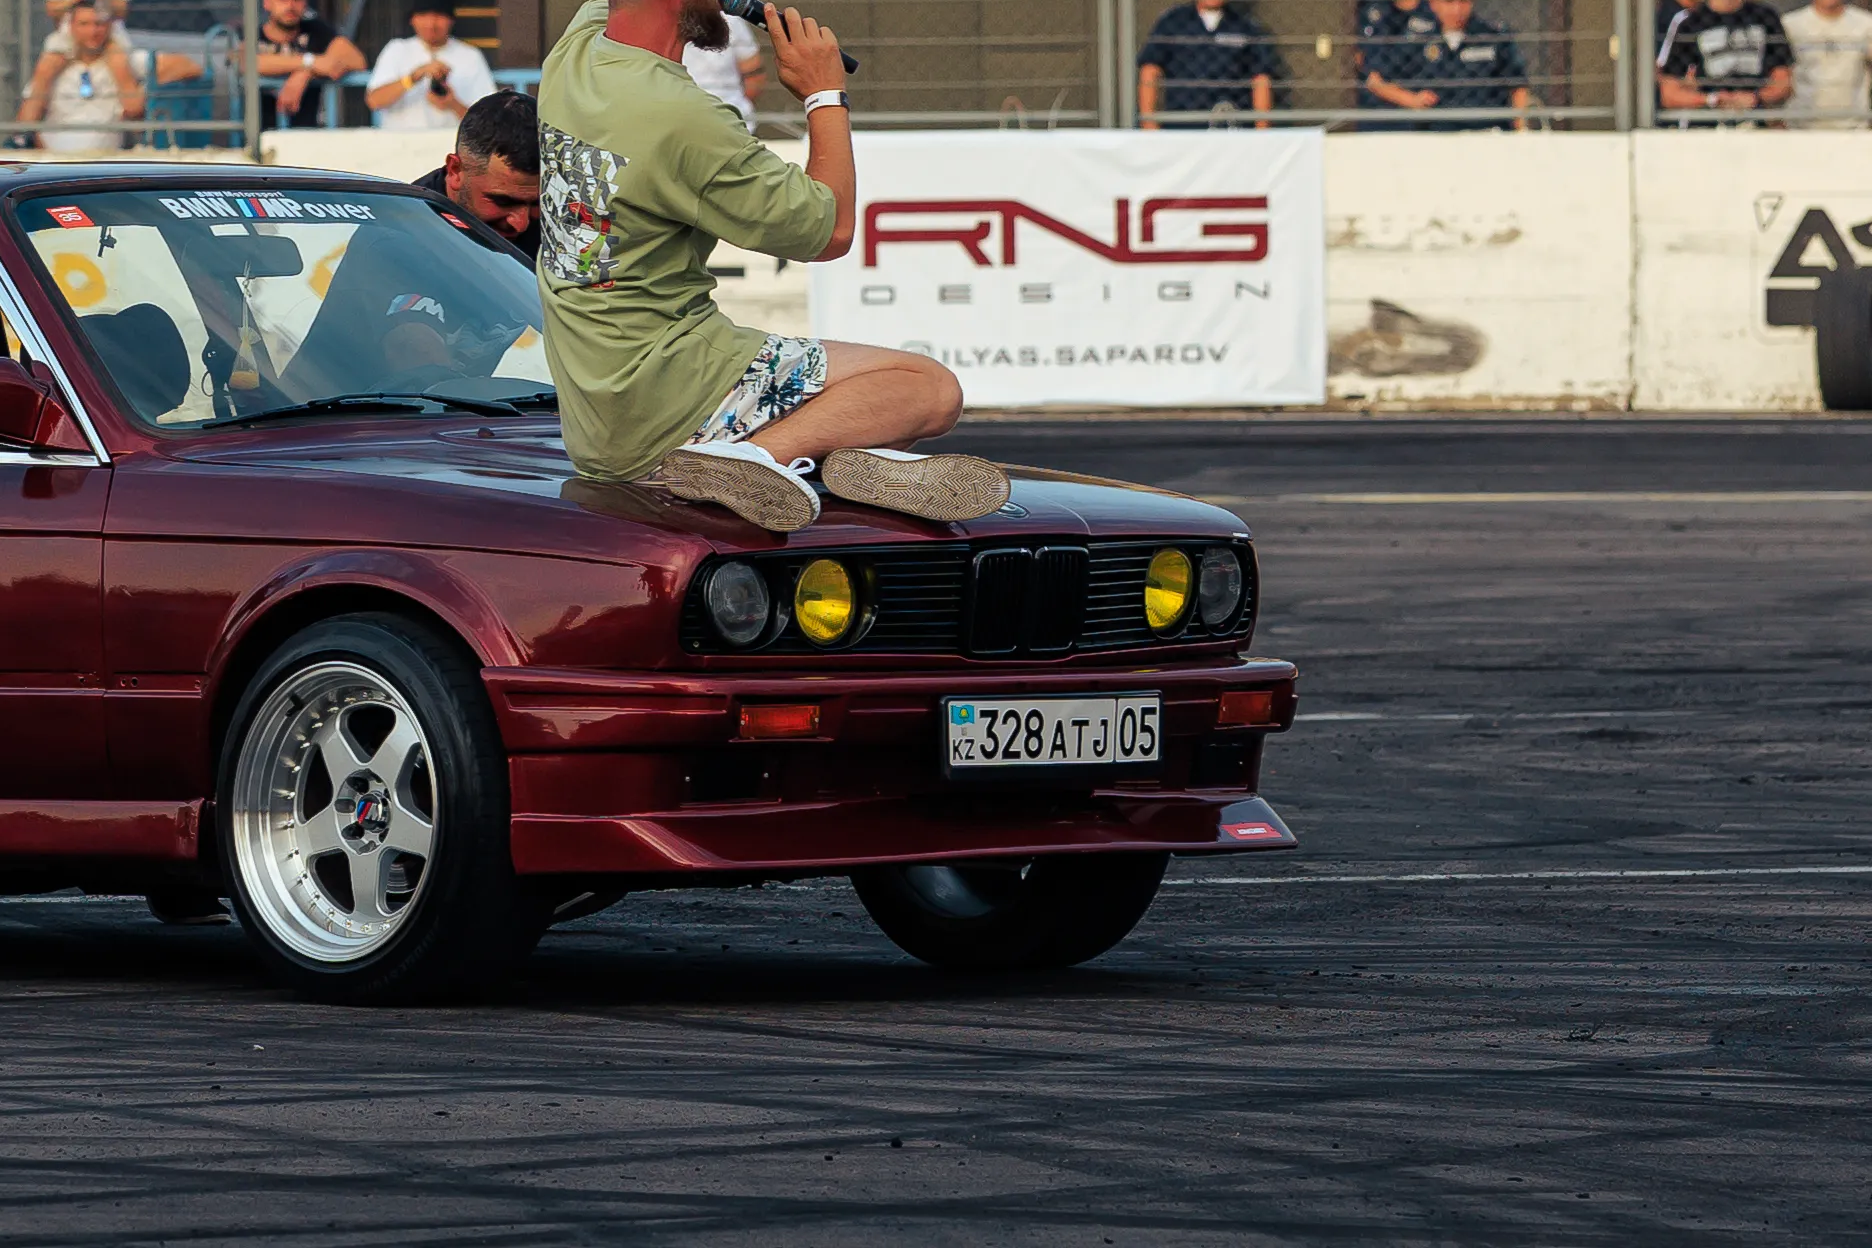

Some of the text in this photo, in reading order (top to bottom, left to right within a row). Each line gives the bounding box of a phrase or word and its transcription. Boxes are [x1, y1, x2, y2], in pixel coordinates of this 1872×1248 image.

[158, 198, 240, 219] BMW
[863, 195, 1269, 269] RNG
[860, 279, 1270, 306] DESIGN
[952, 738, 976, 761] KZ
[1119, 705, 1158, 757] 05
